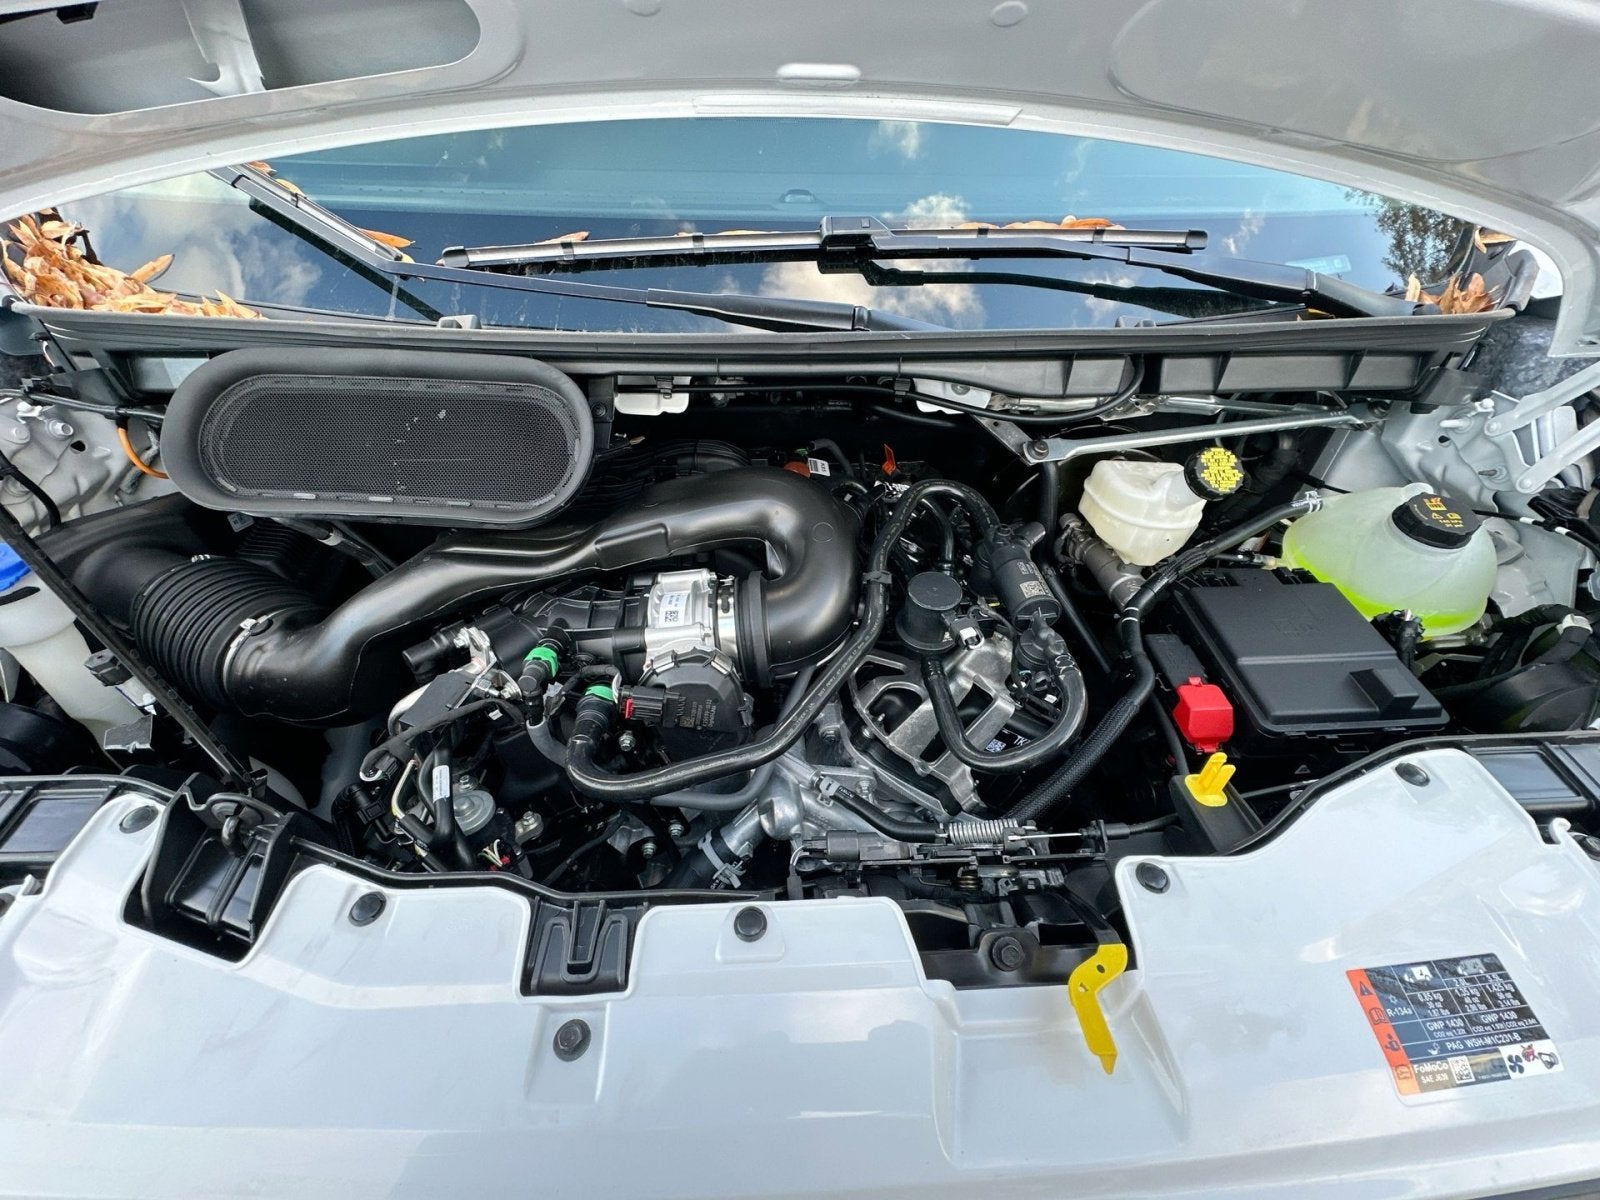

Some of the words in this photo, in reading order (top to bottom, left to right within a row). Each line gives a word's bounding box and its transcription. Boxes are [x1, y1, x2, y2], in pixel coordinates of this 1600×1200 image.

[1455, 987, 1469, 997] 1.35
[1469, 986, 1481, 997] kg
[1487, 983, 1505, 993] 1.425
[1504, 982, 1516, 993] kg
[1417, 991, 1433, 1002] 0.85
[1433, 990, 1444, 1002] kg
[1386, 1007, 1413, 1018] R-134a
[1481, 1013, 1499, 1023] GWP
[1499, 1010, 1518, 1021] 1430
[1426, 1020, 1445, 1031] GWP
[1445, 1018, 1465, 1028] 1430
[1433, 1031, 1445, 1039] CO2
[1445, 1040, 1465, 1051] PAG
[1464, 1032, 1522, 1048] WSH-M1C231-B
[1413, 1061, 1450, 1074] FoMoCo
[1420, 1074, 1435, 1084] SAE
